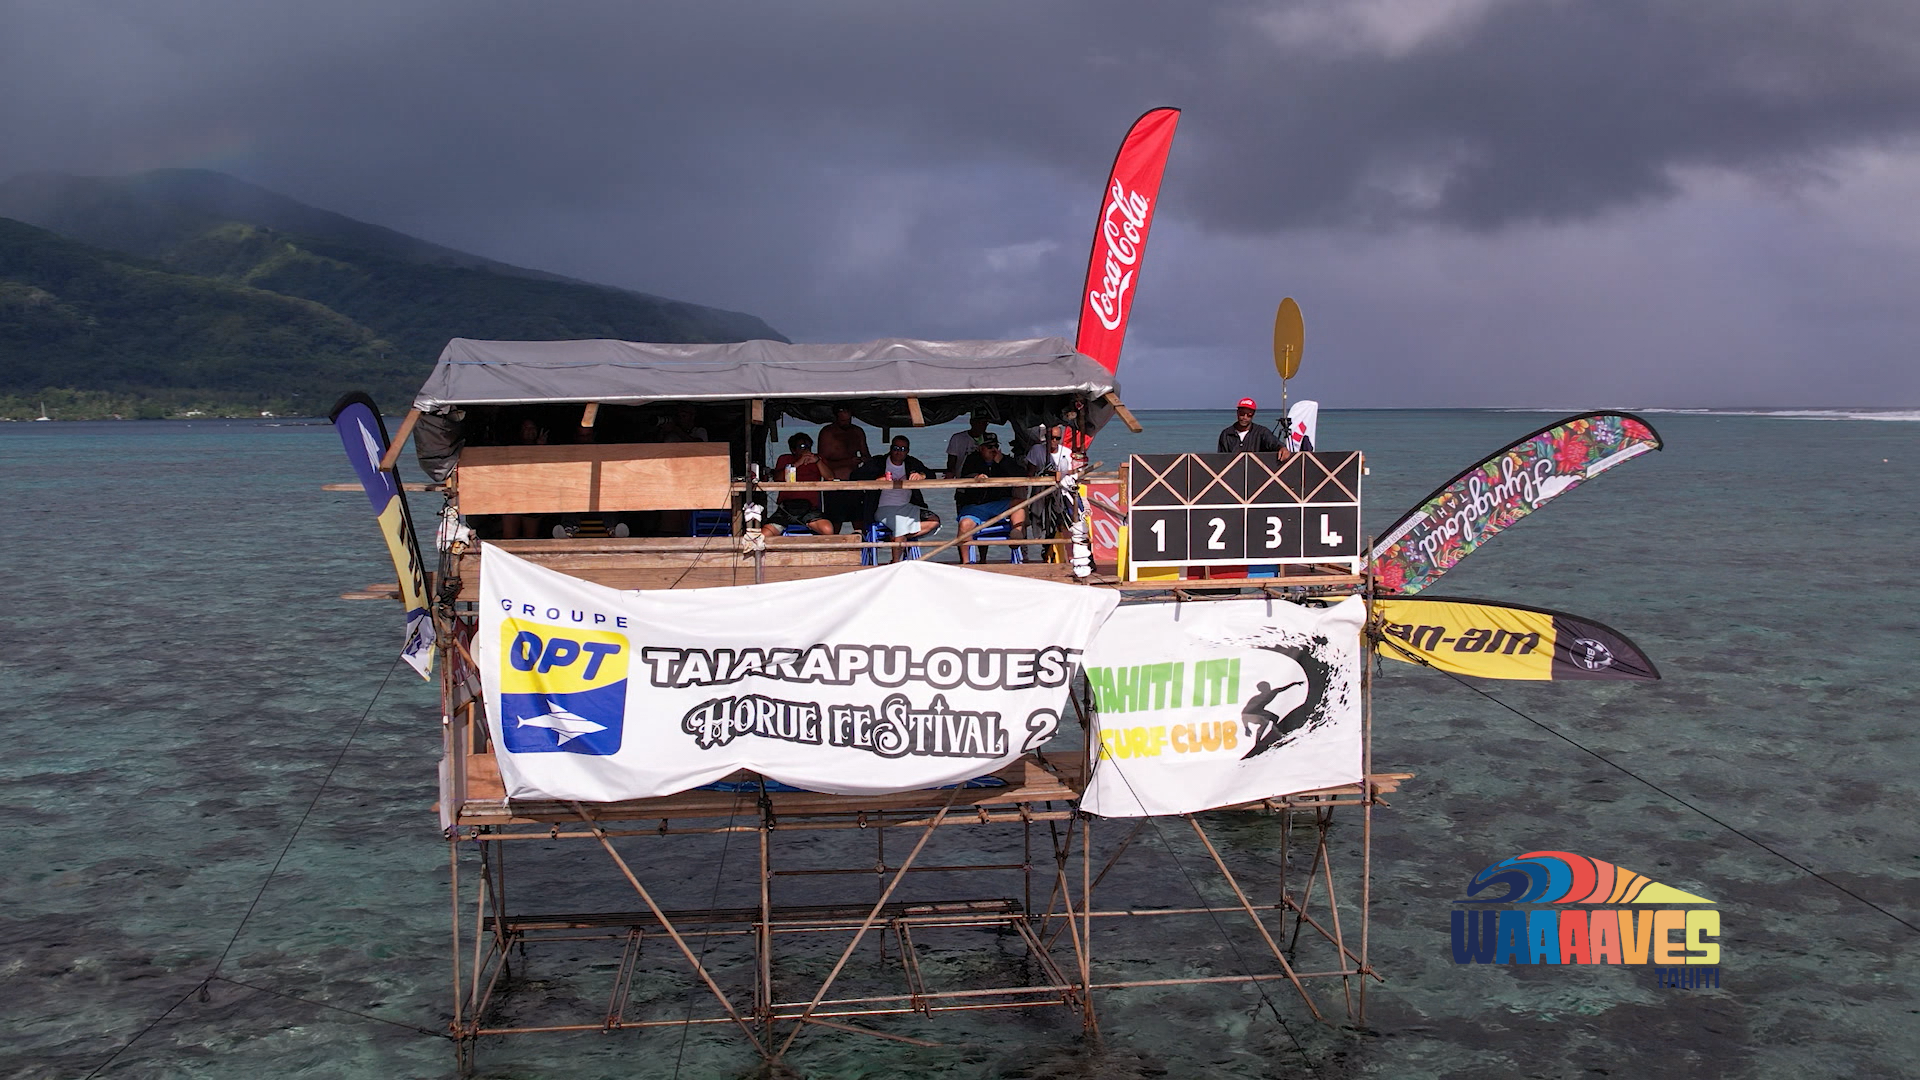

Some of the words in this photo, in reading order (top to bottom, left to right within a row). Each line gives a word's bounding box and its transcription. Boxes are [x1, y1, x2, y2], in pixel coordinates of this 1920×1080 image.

[1090, 178, 1149, 330] Coca-Cola
[1150, 519, 1166, 552] 1
[1207, 517, 1226, 550] 2
[1265, 516, 1283, 549] 3
[1320, 513, 1343, 547] 4
[1391, 513, 1423, 543] SWIMWEAR
[1412, 493, 1468, 537] TAHITI
[1373, 538, 1393, 556] FROM
[500, 598, 629, 629] GROUPE
[510, 631, 621, 681] OPT
[1087, 662, 1184, 713] TAHITI
[1192, 658, 1241, 706] ITI
[681, 694, 822, 750] HORUE
[828, 693, 1009, 759] FESTIVAL
[1099, 725, 1168, 760] SURF
[1171, 720, 1238, 753] CLUB
